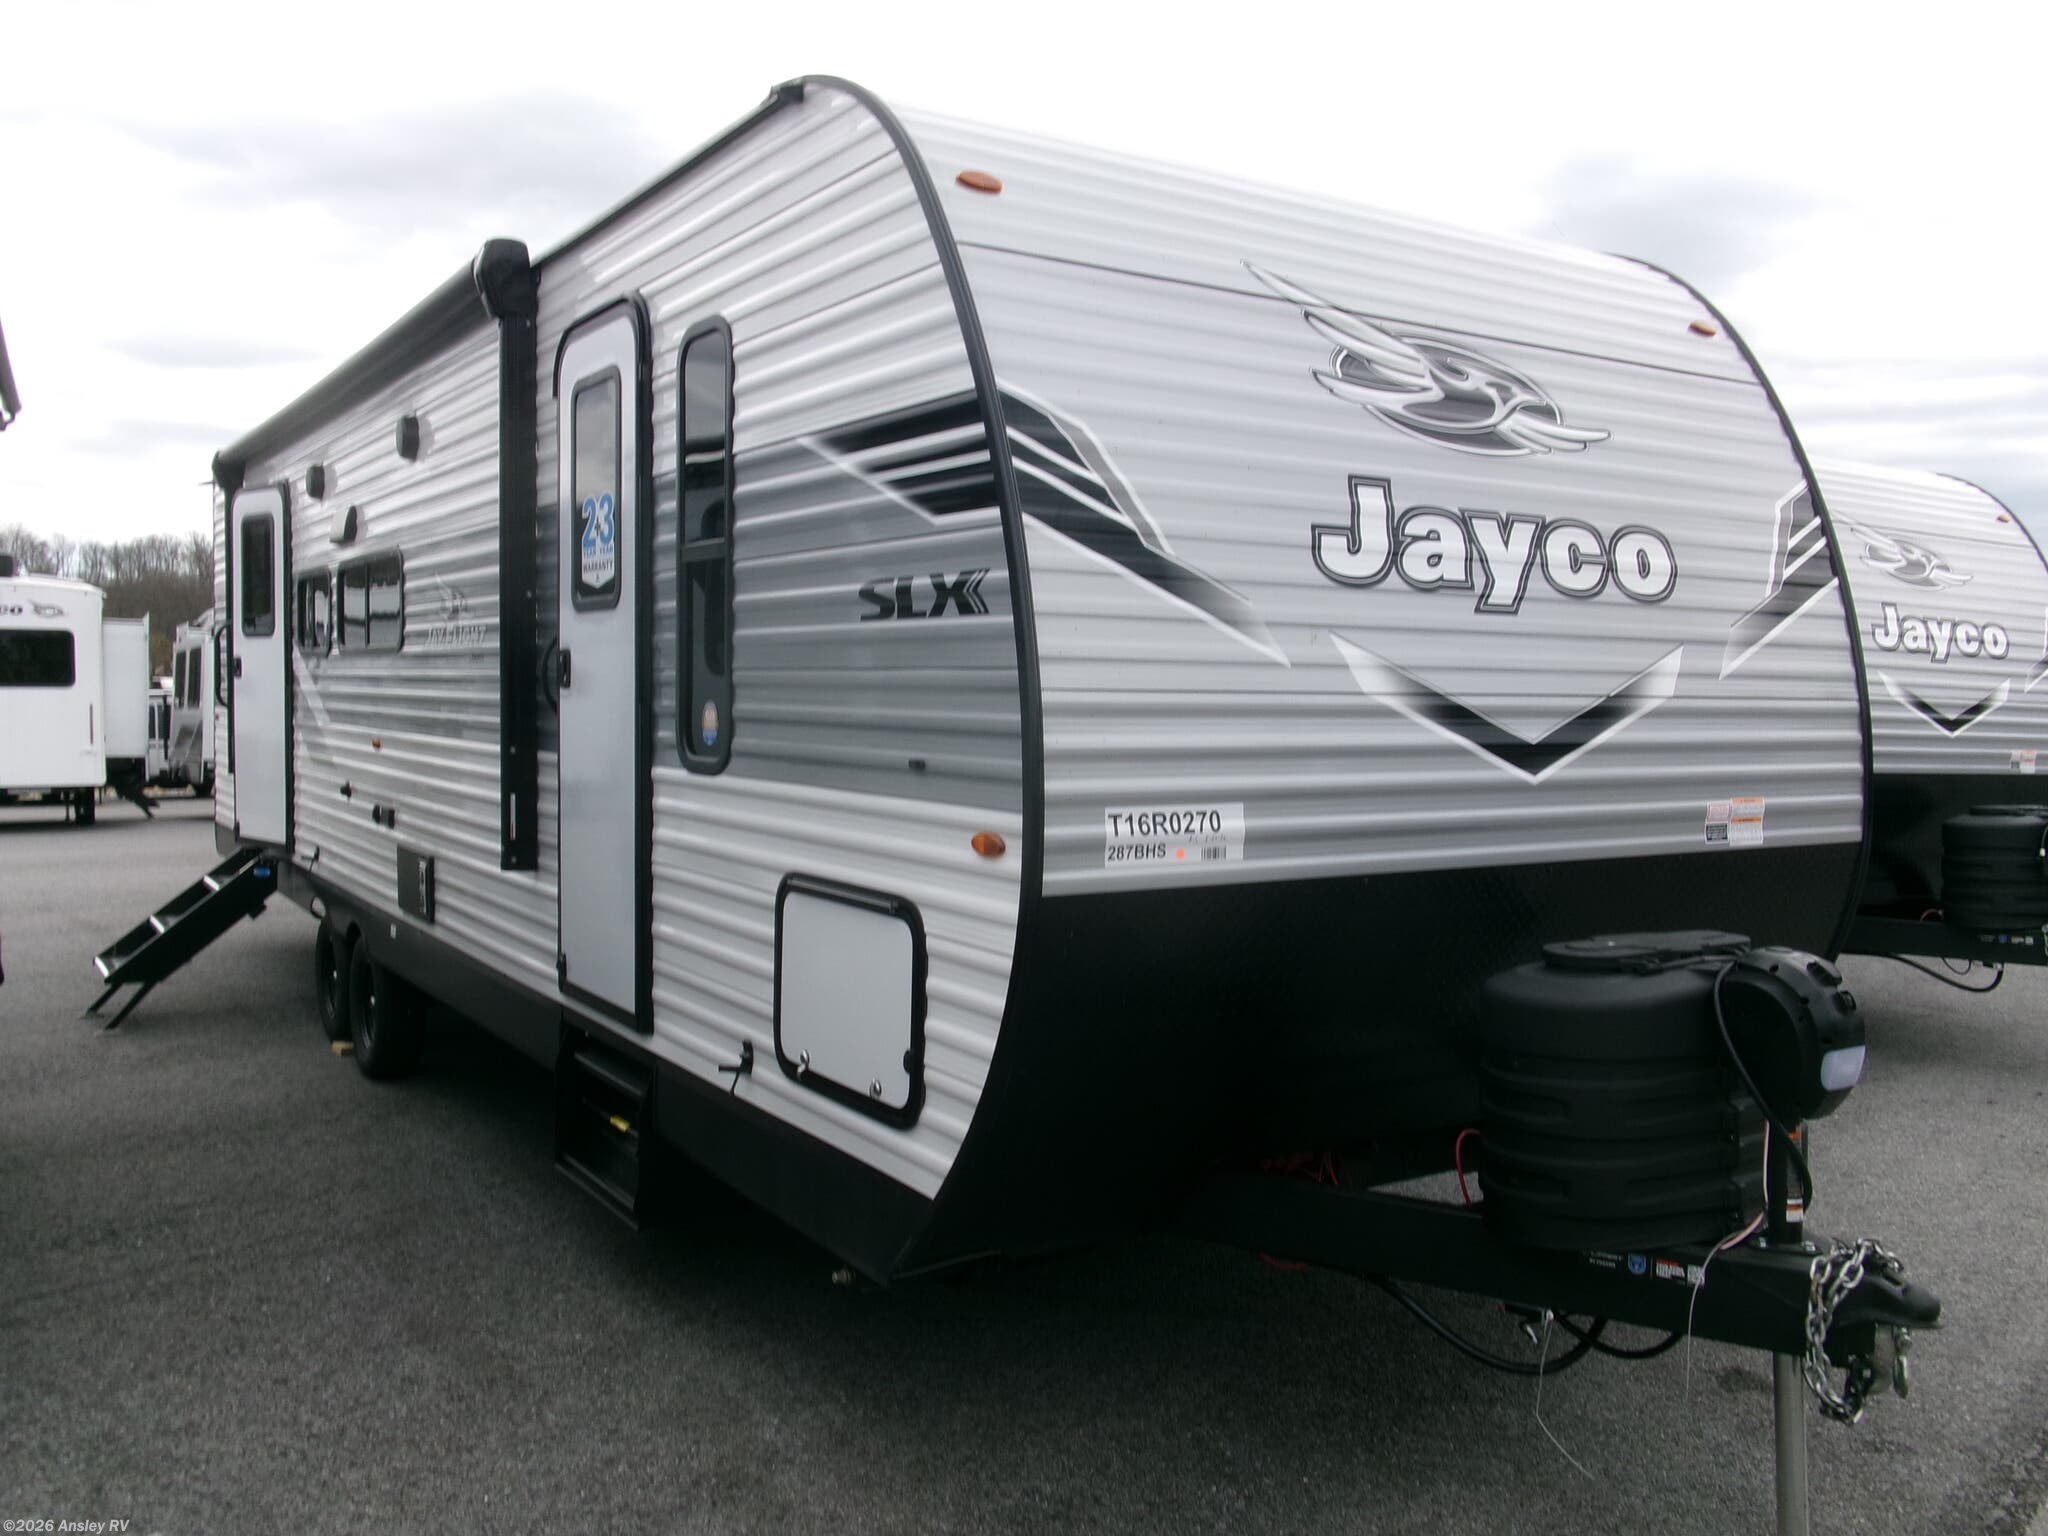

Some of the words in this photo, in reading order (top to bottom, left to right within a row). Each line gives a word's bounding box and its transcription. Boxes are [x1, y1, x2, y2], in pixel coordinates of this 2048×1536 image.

[1311, 474, 1678, 615] Jayco
[858, 567, 988, 622] SLX
[1871, 602, 2010, 664] Jayco
[1107, 810, 1222, 837] T16R0270
[1107, 843, 1167, 862] 287BHS
